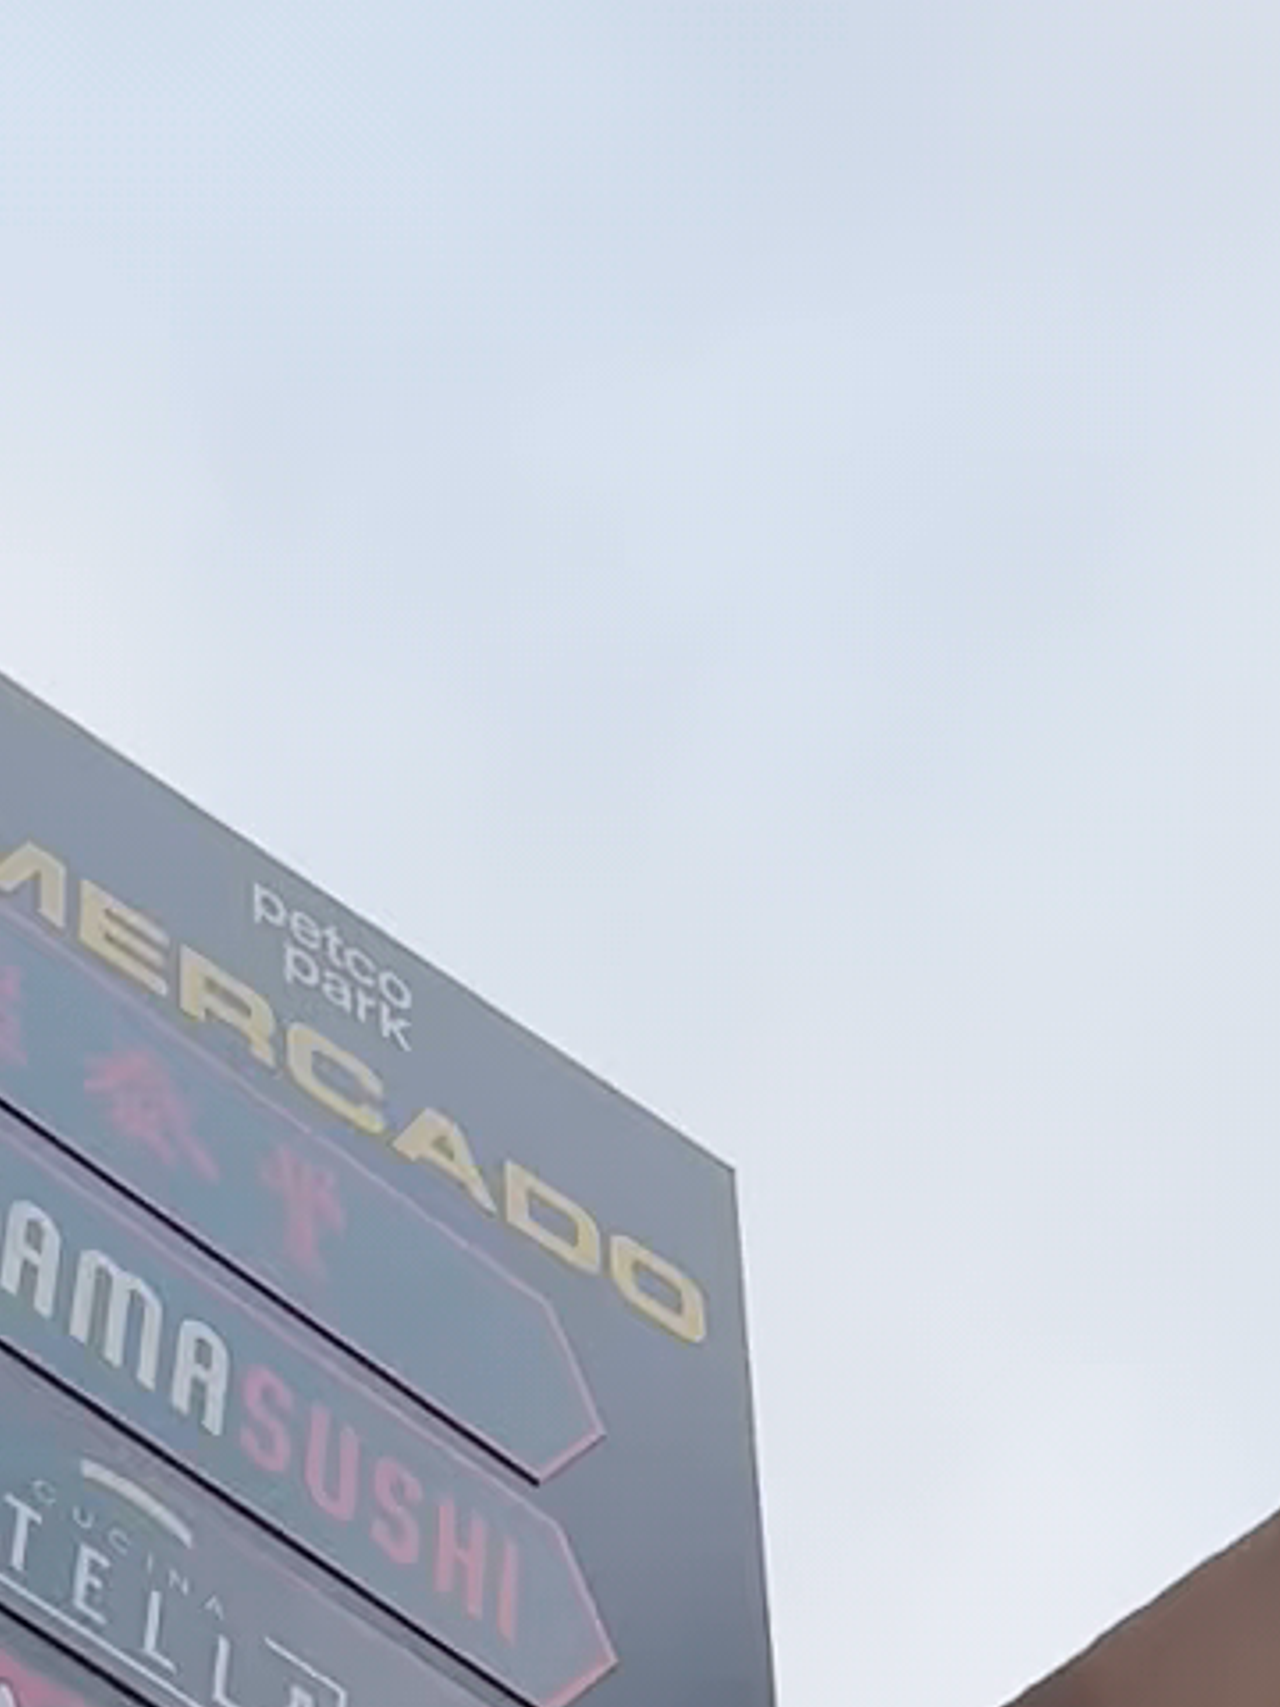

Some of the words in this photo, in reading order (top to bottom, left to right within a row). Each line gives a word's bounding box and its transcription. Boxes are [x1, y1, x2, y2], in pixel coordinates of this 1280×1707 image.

[253, 882, 412, 1010] petco
[284, 941, 412, 1052] park
[32, 1479, 226, 1621] CUCINA
